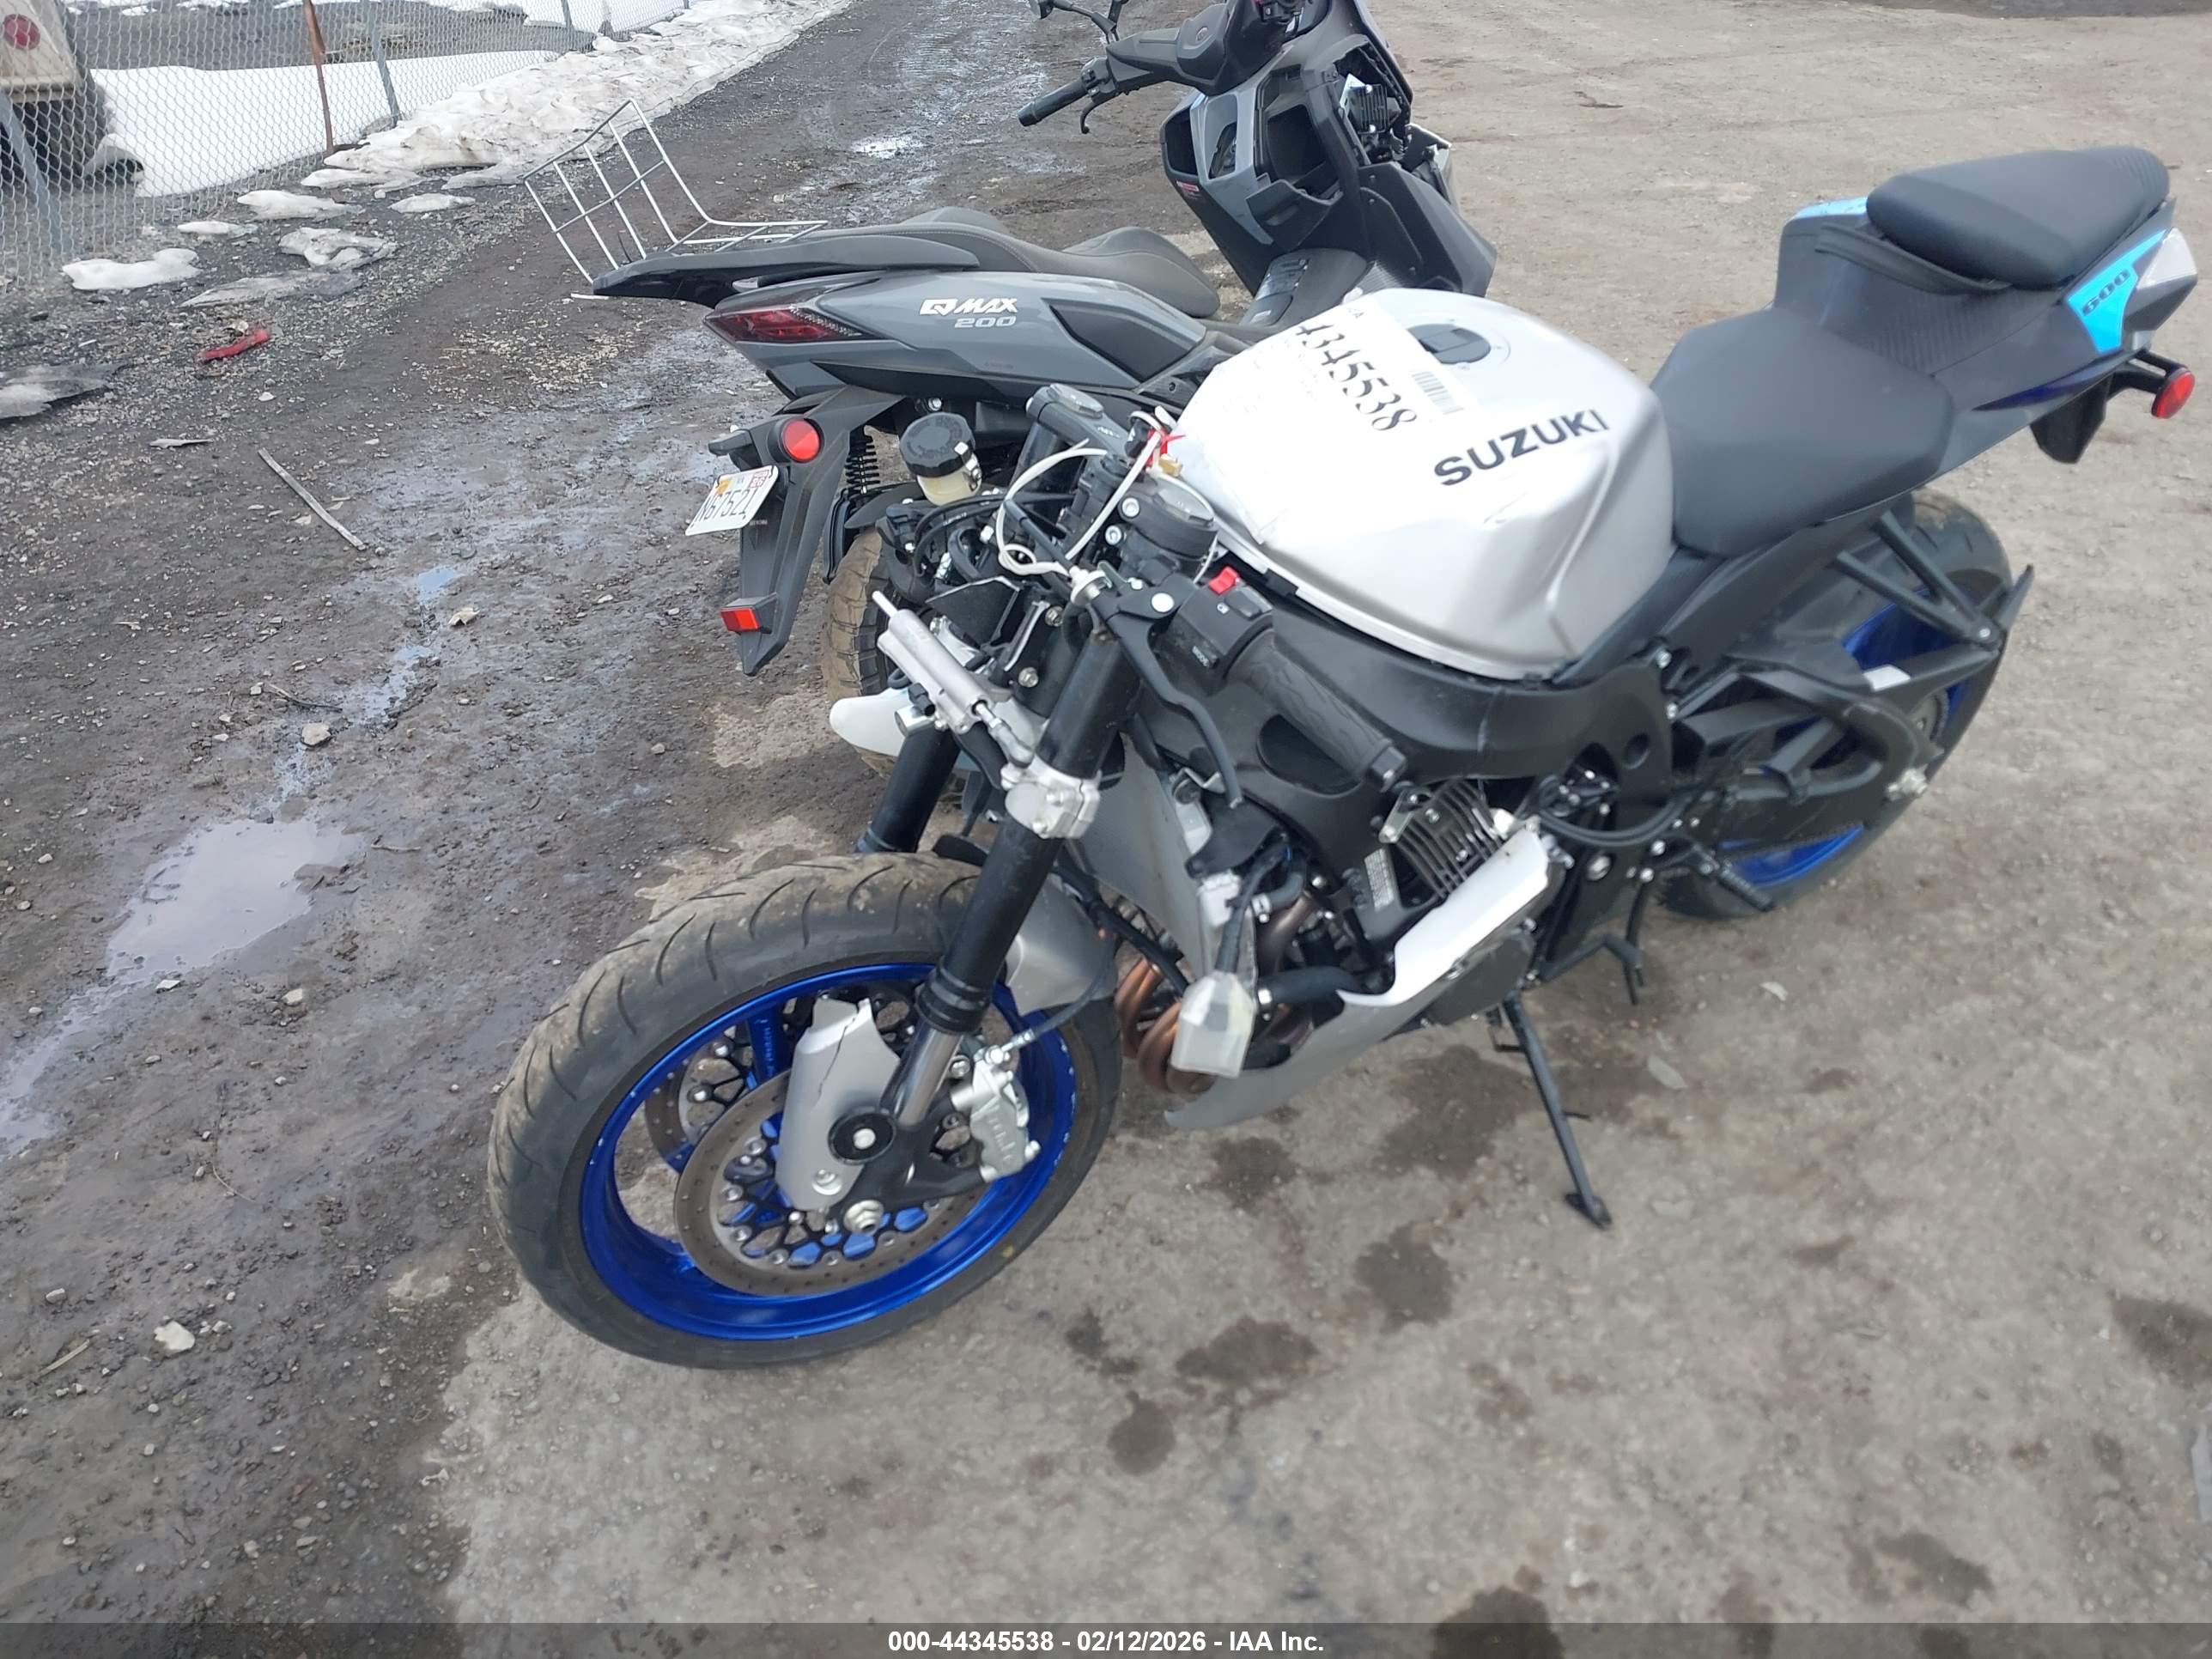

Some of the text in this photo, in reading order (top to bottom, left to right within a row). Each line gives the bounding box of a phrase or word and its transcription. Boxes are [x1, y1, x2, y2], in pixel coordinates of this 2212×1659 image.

[2082, 269, 2130, 316] 600
[954, 315, 1017, 329] 200
[1433, 409, 1610, 486] SUZUKI
